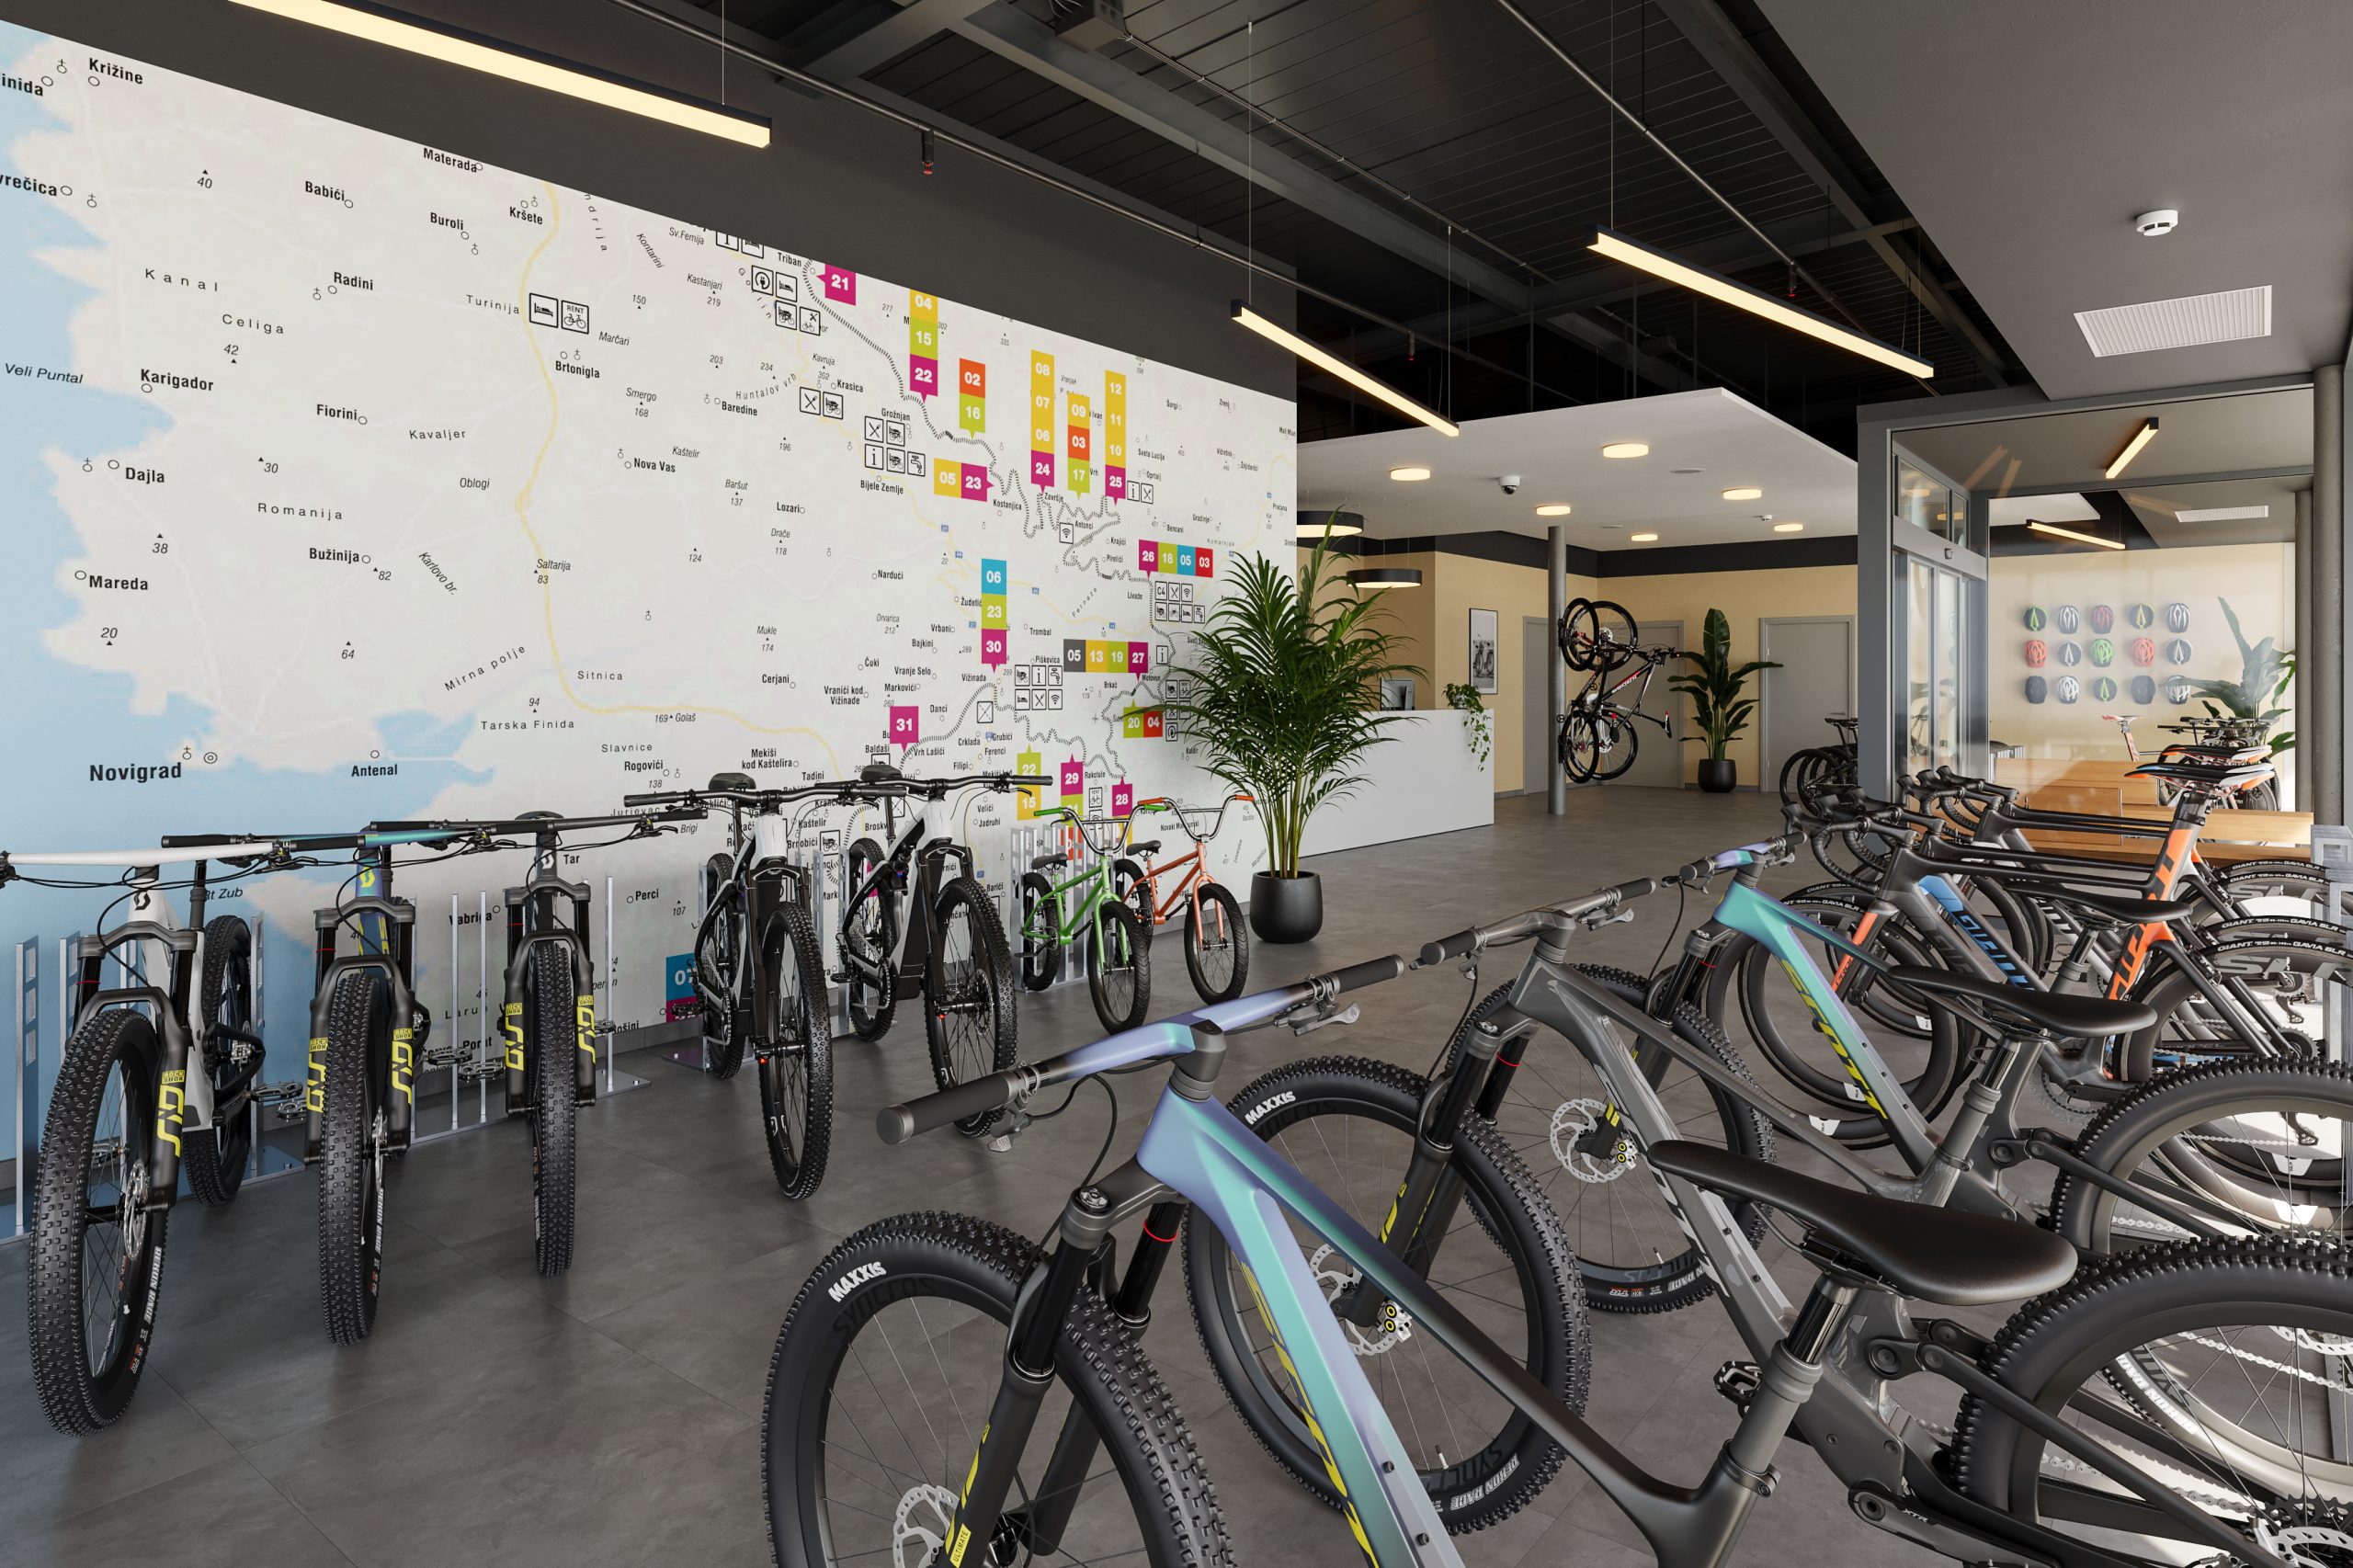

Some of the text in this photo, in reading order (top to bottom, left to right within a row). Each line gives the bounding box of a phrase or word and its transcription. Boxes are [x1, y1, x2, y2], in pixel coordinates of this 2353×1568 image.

[87, 57, 142, 86] Križine
[1, 73, 42, 97] inida
[422, 146, 477, 174] Materada
[305, 180, 344, 200] Babići
[509, 203, 542, 224] Kršete
[430, 211, 463, 230] Buroli
[636, 233, 665, 267] Kontarini
[777, 252, 801, 267] Triban
[334, 271, 372, 290] Radini
[687, 273, 722, 290] Kastanjari
[831, 273, 847, 290] 21
[465, 294, 519, 314] Turinija
[566, 304, 583, 312] RENT
[915, 294, 932, 309] 04
[598, 331, 629, 346] Marčari
[915, 330, 931, 346] 15
[5, 362, 83, 383] Veli Puntal
[555, 359, 599, 378] Brtonigla
[915, 367, 932, 382] 22
[1035, 362, 1050, 375] 08
[141, 368, 213, 392] Karigador
[964, 371, 980, 386] 02
[836, 379, 863, 392] Krasica
[1109, 381, 1121, 394] 12
[625, 387, 656, 402] Smergo
[722, 400, 757, 415] Baredine
[1035, 395, 1050, 408] 07
[316, 403, 357, 420] Fiorini
[881, 407, 910, 421] Grožnjan
[1071, 403, 1086, 417] 09
[1110, 413, 1120, 425] 11
[409, 429, 465, 440] Kavaljer
[1035, 428, 1050, 441] 06
[1072, 435, 1086, 448] 03
[672, 446, 699, 458] Kaštelir
[1109, 444, 1121, 456] 10
[633, 457, 675, 472] Nova Vas
[1035, 461, 1050, 475] 24
[125, 467, 164, 484] Dajla
[939, 471, 981, 489] 05 23
[1073, 469, 1085, 481] 17
[1108, 475, 1122, 487] 25
[460, 477, 490, 490] Oblogi
[860, 479, 904, 494] Bijele Zemlje
[777, 501, 800, 513] Lozari
[993, 498, 1021, 510] Kostanjica
[257, 502, 342, 520] Romanija
[152, 542, 168, 553] 38
[309, 547, 358, 563] Bužinija
[1142, 550, 1210, 567] 26 18 05 03
[418, 551, 447, 583] Karlovo
[536, 558, 570, 572] Saltarija
[89, 574, 147, 590] Mareda
[985, 570, 1001, 583] 06
[1156, 586, 1165, 595] C4
[986, 605, 1001, 618] 23
[100, 627, 118, 638] 20
[930, 623, 951, 632] Vrbani
[1029, 627, 1051, 635] Trombal
[912, 638, 933, 648] Bajkini
[985, 640, 1001, 653] 30
[864, 655, 879, 666] Čuki
[1066, 649, 1144, 663] 05 13 19 27
[444, 646, 525, 690] Mirna polje
[893, 665, 931, 676] Vranje Selo
[577, 670, 622, 680] Sitnica
[761, 674, 789, 685] Cerjani
[961, 673, 986, 681] Vižinada
[884, 683, 915, 691] Markovići
[830, 696, 859, 704] Vižinade
[929, 704, 947, 712] Danci
[675, 712, 696, 722] Golaš
[1128, 717, 1140, 728] 20
[480, 720, 574, 730] Tarska Finida
[895, 718, 912, 731] 31
[958, 737, 980, 745] Crklada
[991, 732, 1012, 741] Grubići
[601, 744, 652, 753] Slavnice
[751, 747, 776, 757] Mekiši
[865, 744, 889, 753] Baldaši
[624, 759, 663, 772] Rogovići
[757, 757, 791, 768] Kaštelira
[89, 761, 181, 783] Novigrad
[351, 763, 397, 777] Antenal
[801, 771, 824, 781] Tadini
[1064, 772, 1078, 784] 29
[1115, 793, 1128, 805] 28
[976, 804, 993, 812] Velići
[978, 817, 1000, 827] Jadruhi
[679, 823, 698, 835] Brigi
[563, 854, 579, 864] Tar
[2233, 861, 2256, 870] GIANT
[2230, 874, 2256, 883] GIANT
[218, 887, 243, 899] Zub
[635, 888, 658, 901] Perci
[1806, 883, 1832, 893] GIANT
[1822, 899, 1860, 912] GAVIA SLR
[2222, 919, 2253, 929] GIANT
[2290, 919, 2318, 928] GAVIA
[2319, 923, 2339, 932] SLR
[2217, 941, 2253, 952] GIANT
[2293, 941, 2323, 951] GAVIA
[2325, 947, 2347, 956] SLR
[1245, 1091, 1296, 1125] MAXXIS
[828, 1261, 886, 1302] MAXXIS
[953, 1530, 969, 1562] ULTIMATE
